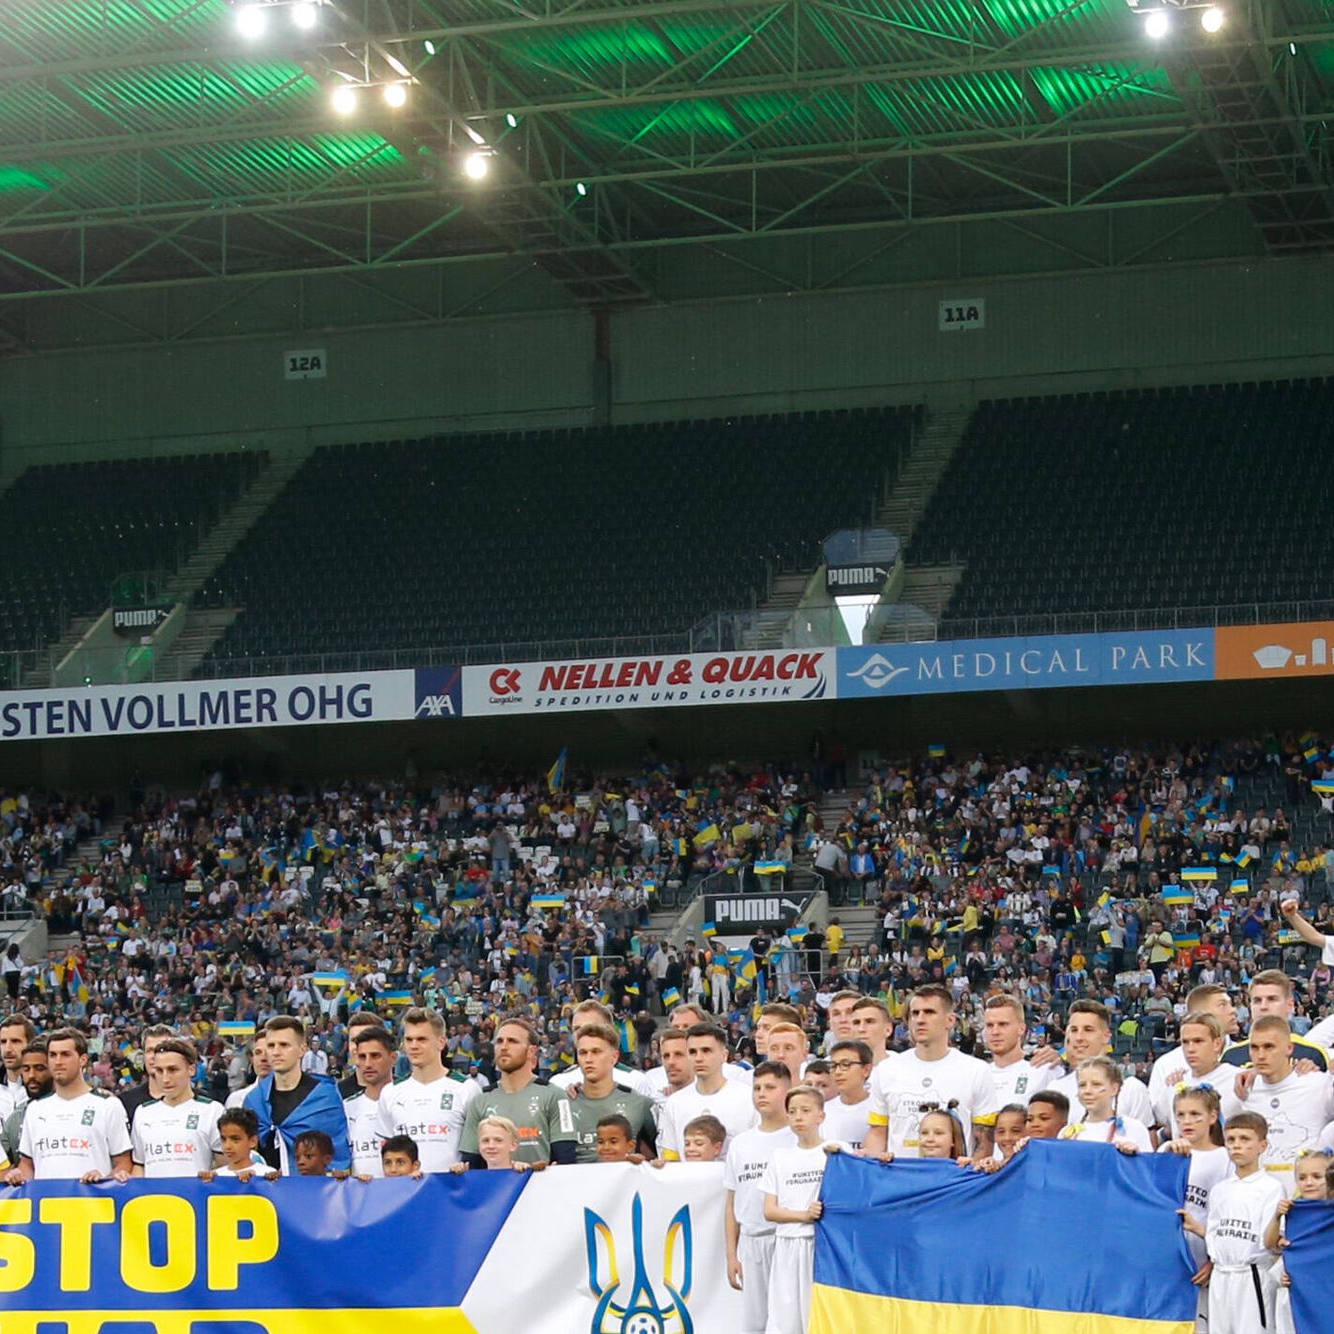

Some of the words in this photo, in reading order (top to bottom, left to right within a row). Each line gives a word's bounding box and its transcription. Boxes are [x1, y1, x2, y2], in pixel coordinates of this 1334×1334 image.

[944, 306, 979, 323] 11A
[289, 356, 322, 372] 12A
[828, 567, 874, 585] PUMA
[114, 610, 157, 628] PUMA
[538, 660, 665, 692] NELLEN
[667, 658, 693, 684] &
[702, 652, 825, 686] QUACK
[918, 646, 1089, 681] MEDICAL
[1111, 642, 1206, 671] PARK
[101, 689, 278, 731] VOLLMER
[288, 683, 373, 721] OHG
[414, 693, 455, 717] AXA
[535, 692, 638, 708] SPEDITION
[651, 690, 688, 701] UND
[700, 686, 791, 700] LOGISTIK
[715, 898, 779, 922] PUMA
